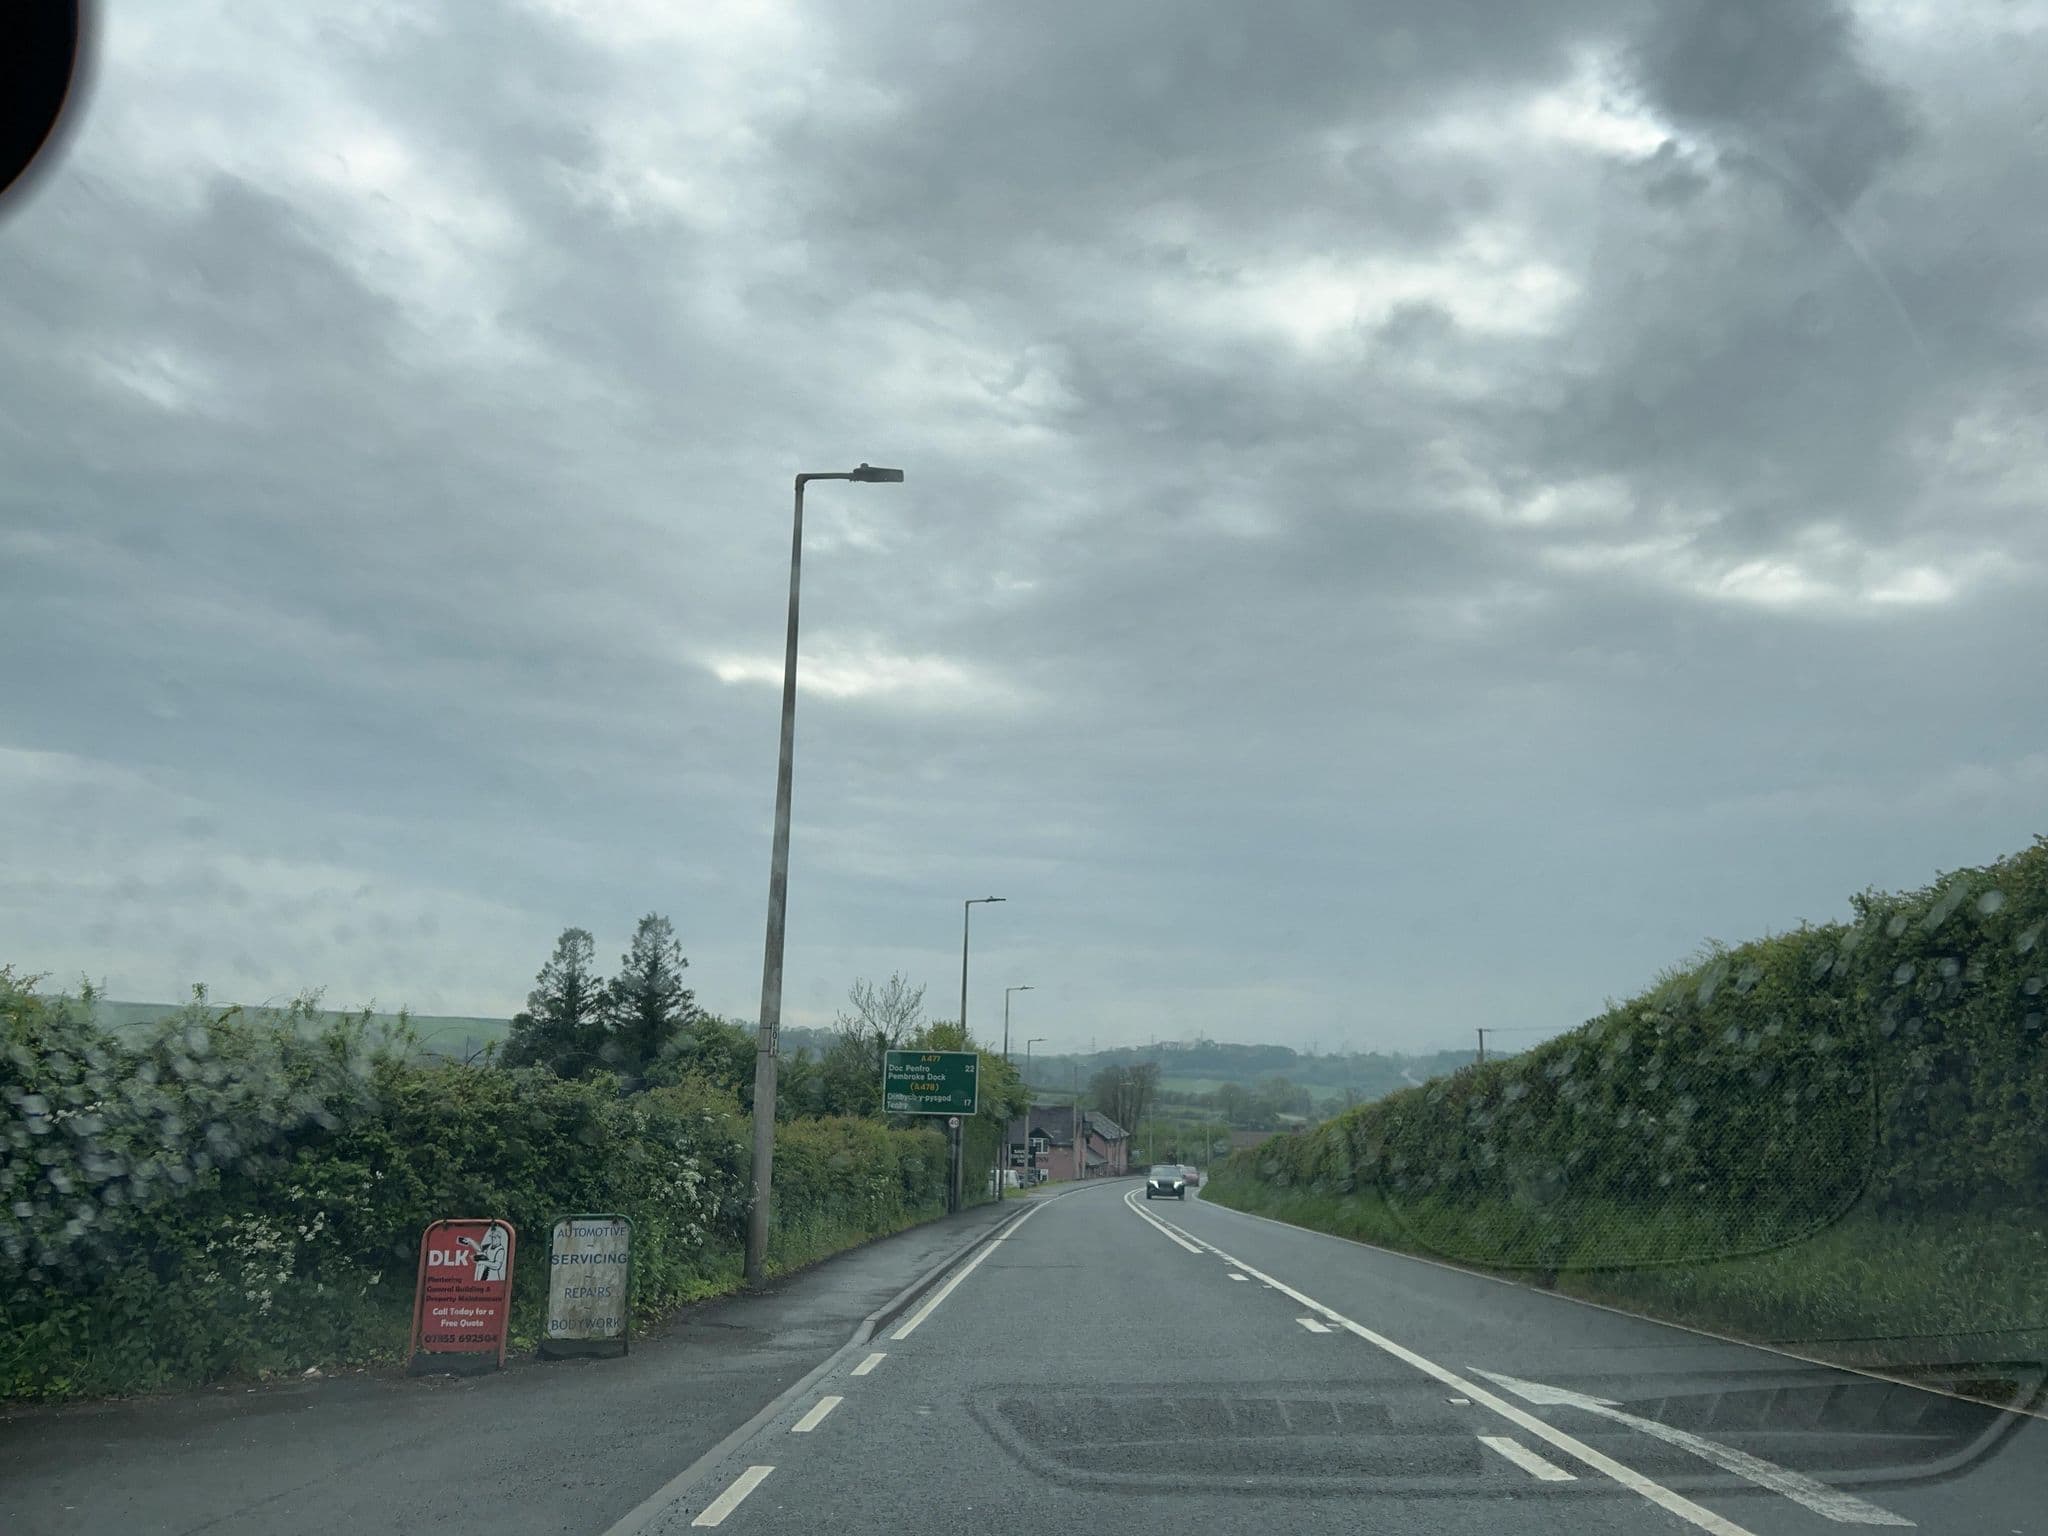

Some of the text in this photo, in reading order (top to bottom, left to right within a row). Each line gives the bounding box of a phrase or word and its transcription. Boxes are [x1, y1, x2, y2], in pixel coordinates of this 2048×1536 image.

[906, 1064, 930, 1072] Penfro
[965, 1065, 975, 1073] 22
[927, 1073, 946, 1081] Dock
[910, 1083, 939, 1092] (A478)
[557, 1226, 627, 1238] AUTOMOTIVE
[428, 1249, 470, 1266] DLK
[551, 1253, 627, 1265] SERVICING
[564, 1286, 611, 1299] REPAIRS
[432, 1307, 449, 1316] Call
[450, 1307, 474, 1317] Today
[475, 1307, 487, 1316] for
[441, 1319, 484, 1328] Free Quote
[551, 1317, 620, 1331] BODYWORK
